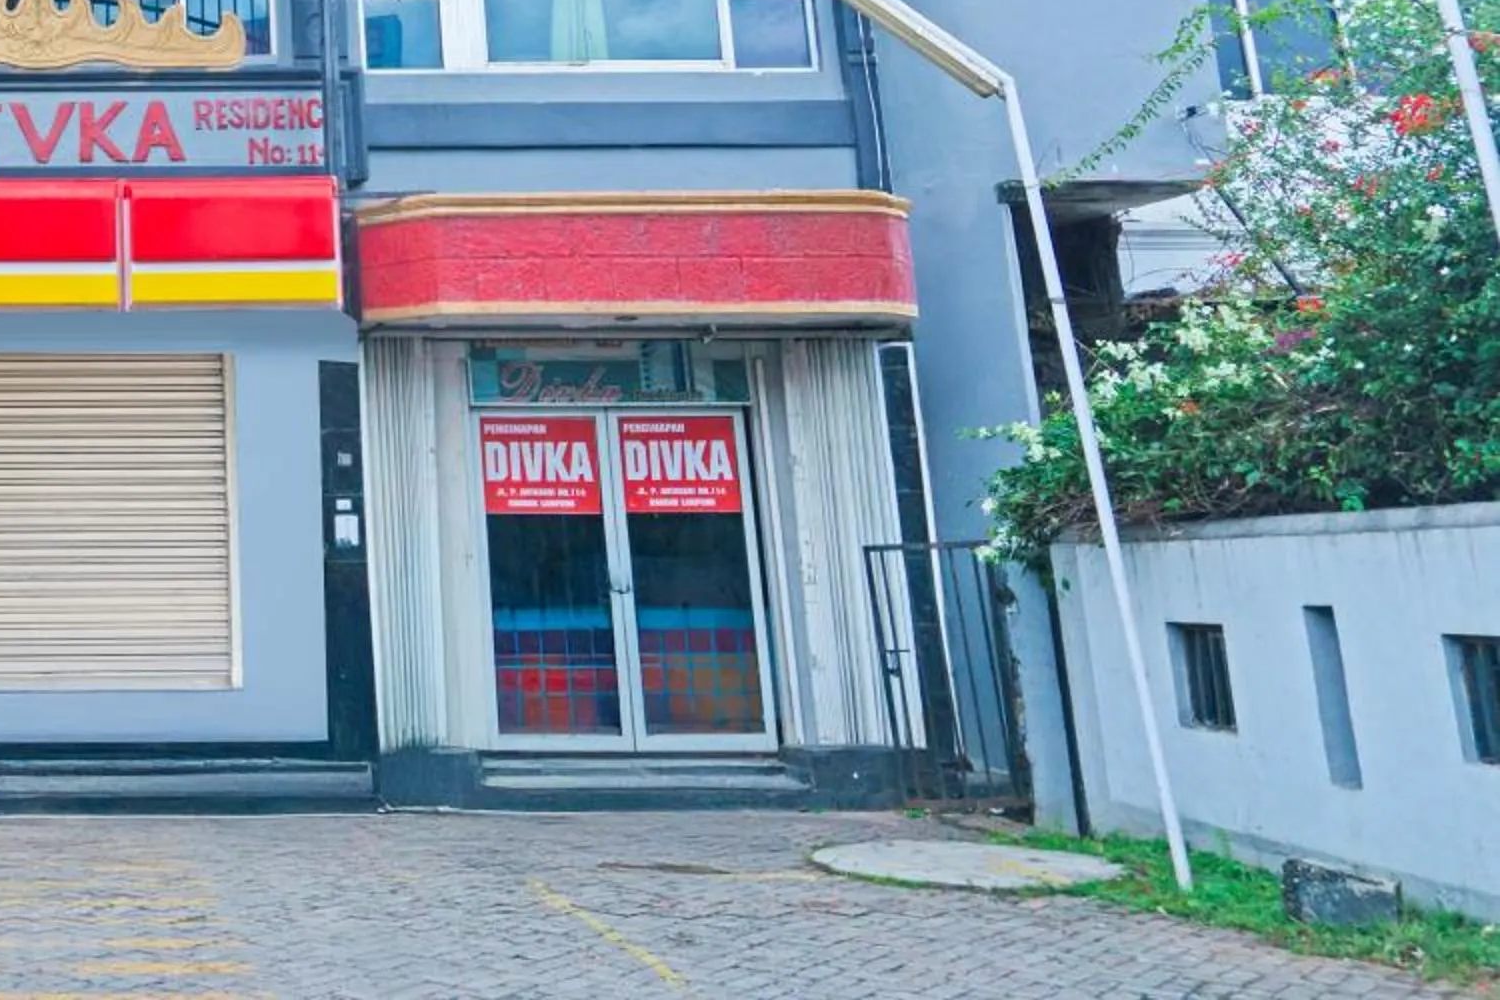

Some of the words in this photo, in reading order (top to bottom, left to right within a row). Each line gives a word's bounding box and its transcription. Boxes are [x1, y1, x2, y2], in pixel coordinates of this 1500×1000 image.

[194, 98, 323, 130] RESIDENC
[297, 144, 324, 165] 11
[484, 441, 594, 482] DIVKA
[624, 440, 733, 481] DIVKA
